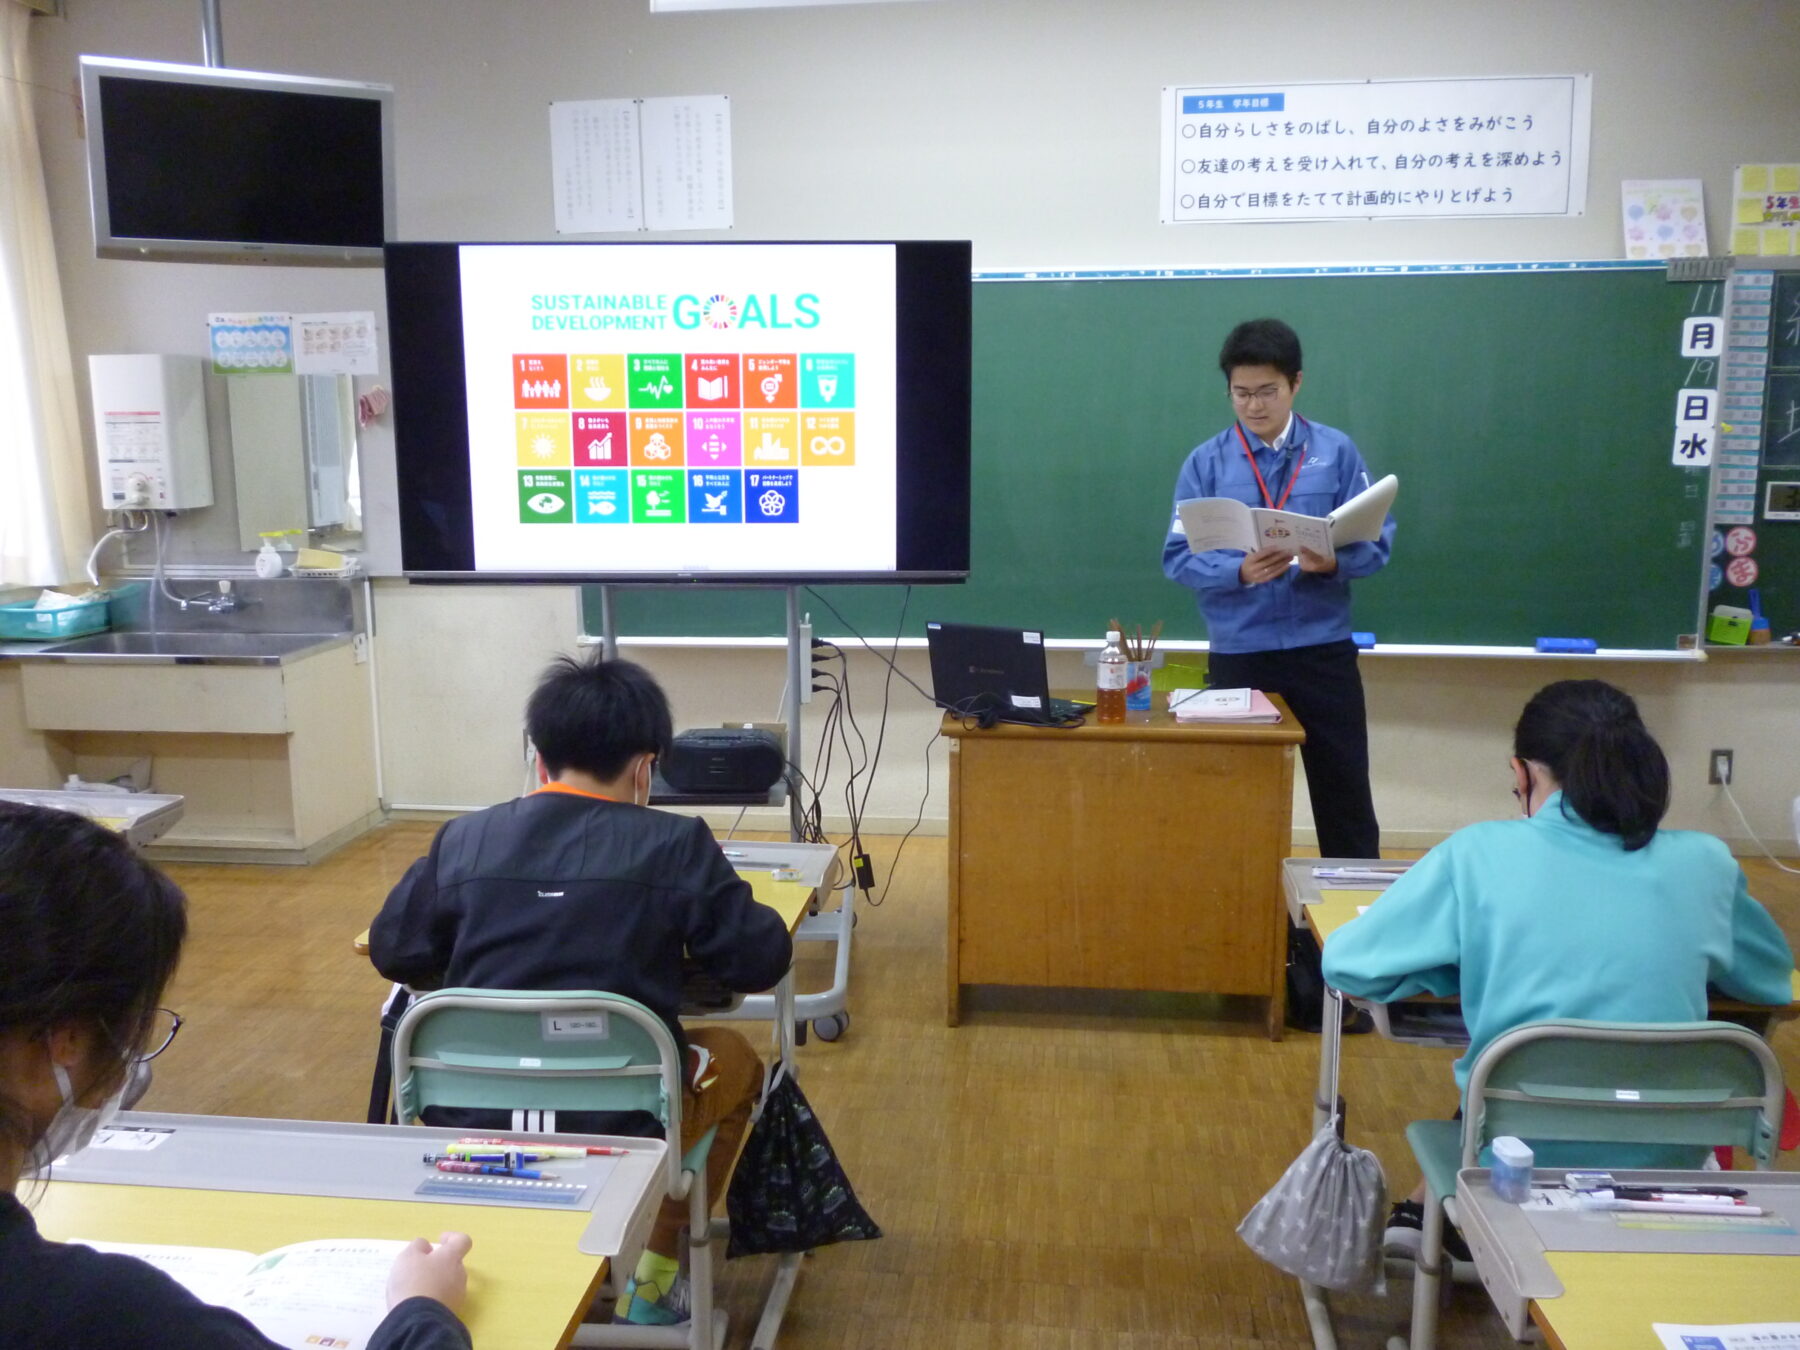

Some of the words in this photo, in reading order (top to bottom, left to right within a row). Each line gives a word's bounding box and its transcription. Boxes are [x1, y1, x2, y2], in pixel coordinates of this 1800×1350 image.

[531, 294, 668, 311] SUSTAINABLE
[531, 315, 668, 330] DEVELOPMENT
[1689, 323, 1714, 350] 月
[691, 359, 698, 371] 4
[1684, 358, 1714, 387] 19
[1683, 395, 1709, 420] 日
[692, 417, 704, 430] 10
[1679, 432, 1707, 459] 水
[750, 474, 760, 487] 17
[553, 1020, 562, 1031] L
